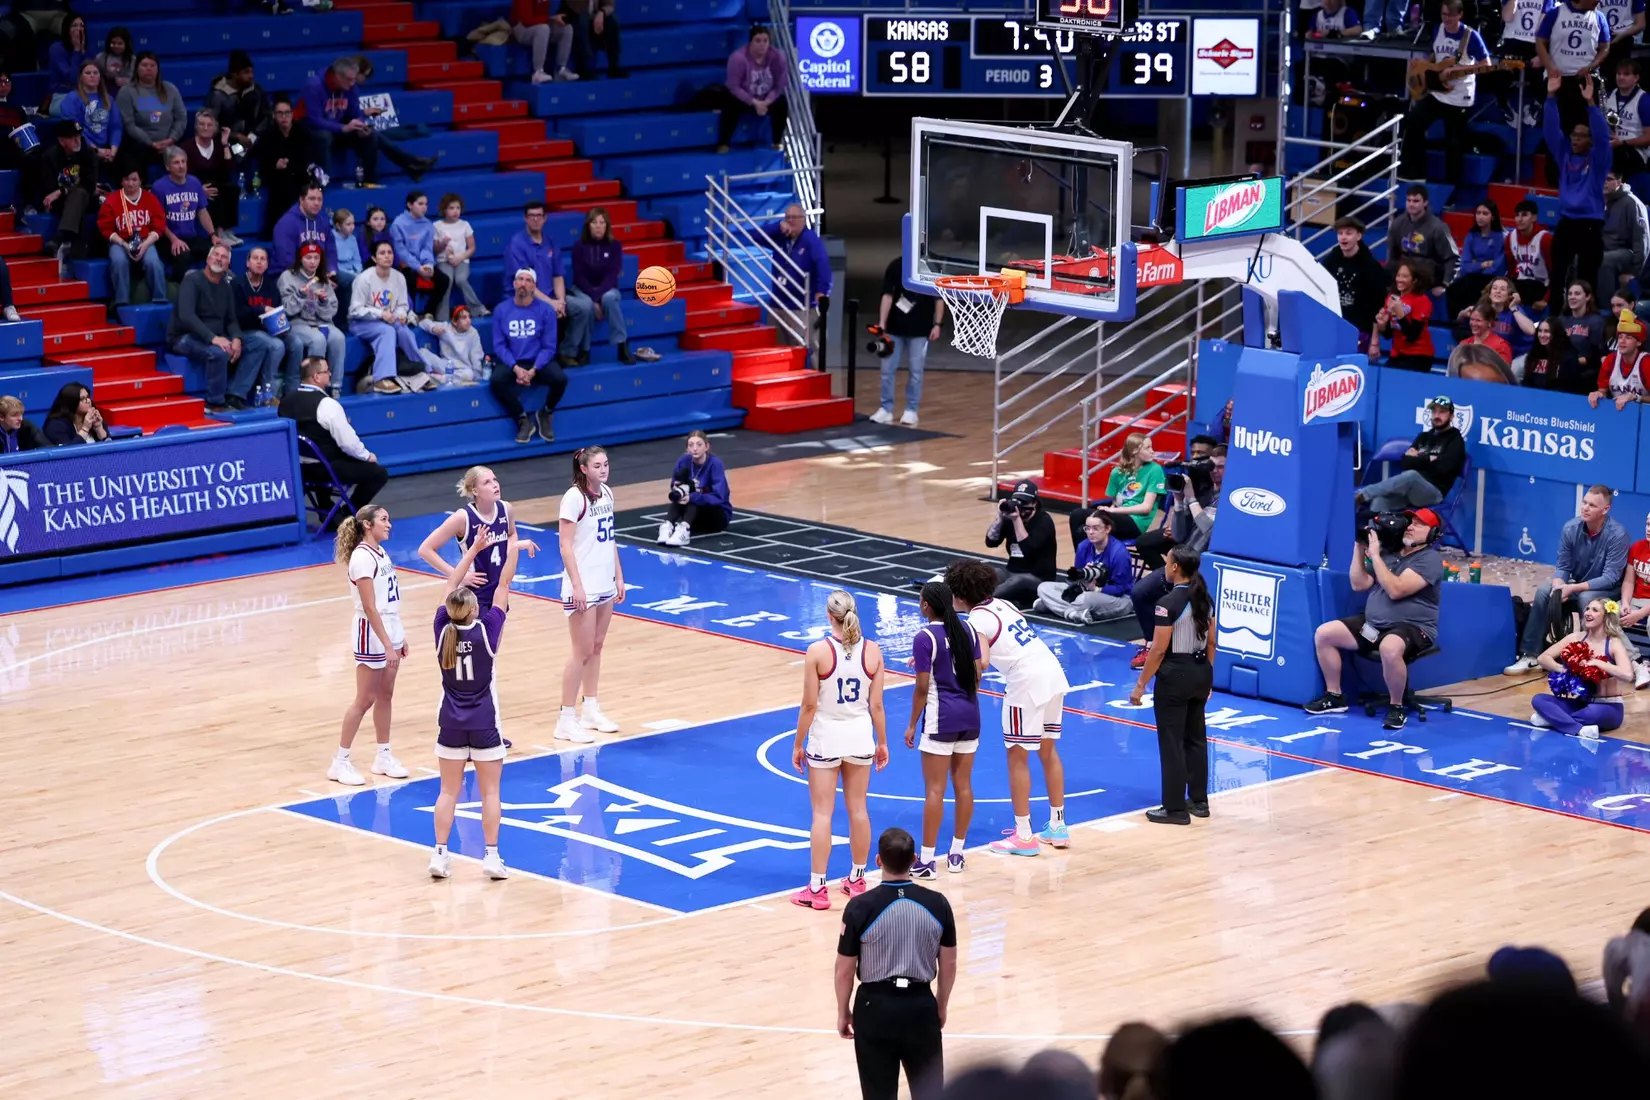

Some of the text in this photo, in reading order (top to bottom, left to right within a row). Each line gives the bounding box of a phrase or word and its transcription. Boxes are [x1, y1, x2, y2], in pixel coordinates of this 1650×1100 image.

[1060, 18, 1102, 27] DAKTRONICS
[1521, 11, 1534, 31] 6
[1561, 20, 1593, 31] KANSAS
[1606, 8, 1619, 27] 6
[887, 20, 949, 41] KANSAS
[1568, 29, 1582, 49] 6
[799, 59, 850, 75] Capitol
[890, 51, 930, 83] 58
[986, 70, 1030, 83] PERIOD
[1040, 64, 1052, 88] 3
[1134, 52, 1172, 84] 39
[800, 74, 850, 88] Federal
[1204, 184, 1261, 234] LIBMAN
[1247, 255, 1272, 283] KU
[509, 319, 535, 337] 912
[1306, 374, 1358, 418] LIBMAN
[1506, 410, 1595, 433] BlueCross BlueShield
[1478, 416, 1595, 461] Kansas
[38, 459, 246, 507] THE UNIVERSITY OF
[43, 480, 290, 533] KANSAS HEALTH SYSTEM
[1240, 492, 1274, 512] Ford
[597, 516, 615, 542] 52
[491, 546, 501, 566] 4
[1222, 600, 1270, 617] INSURANCE
[1223, 588, 1271, 608] SHELTER
[1008, 619, 1037, 646] 25
[456, 655, 474, 680] 11
[837, 678, 860, 703] 13
